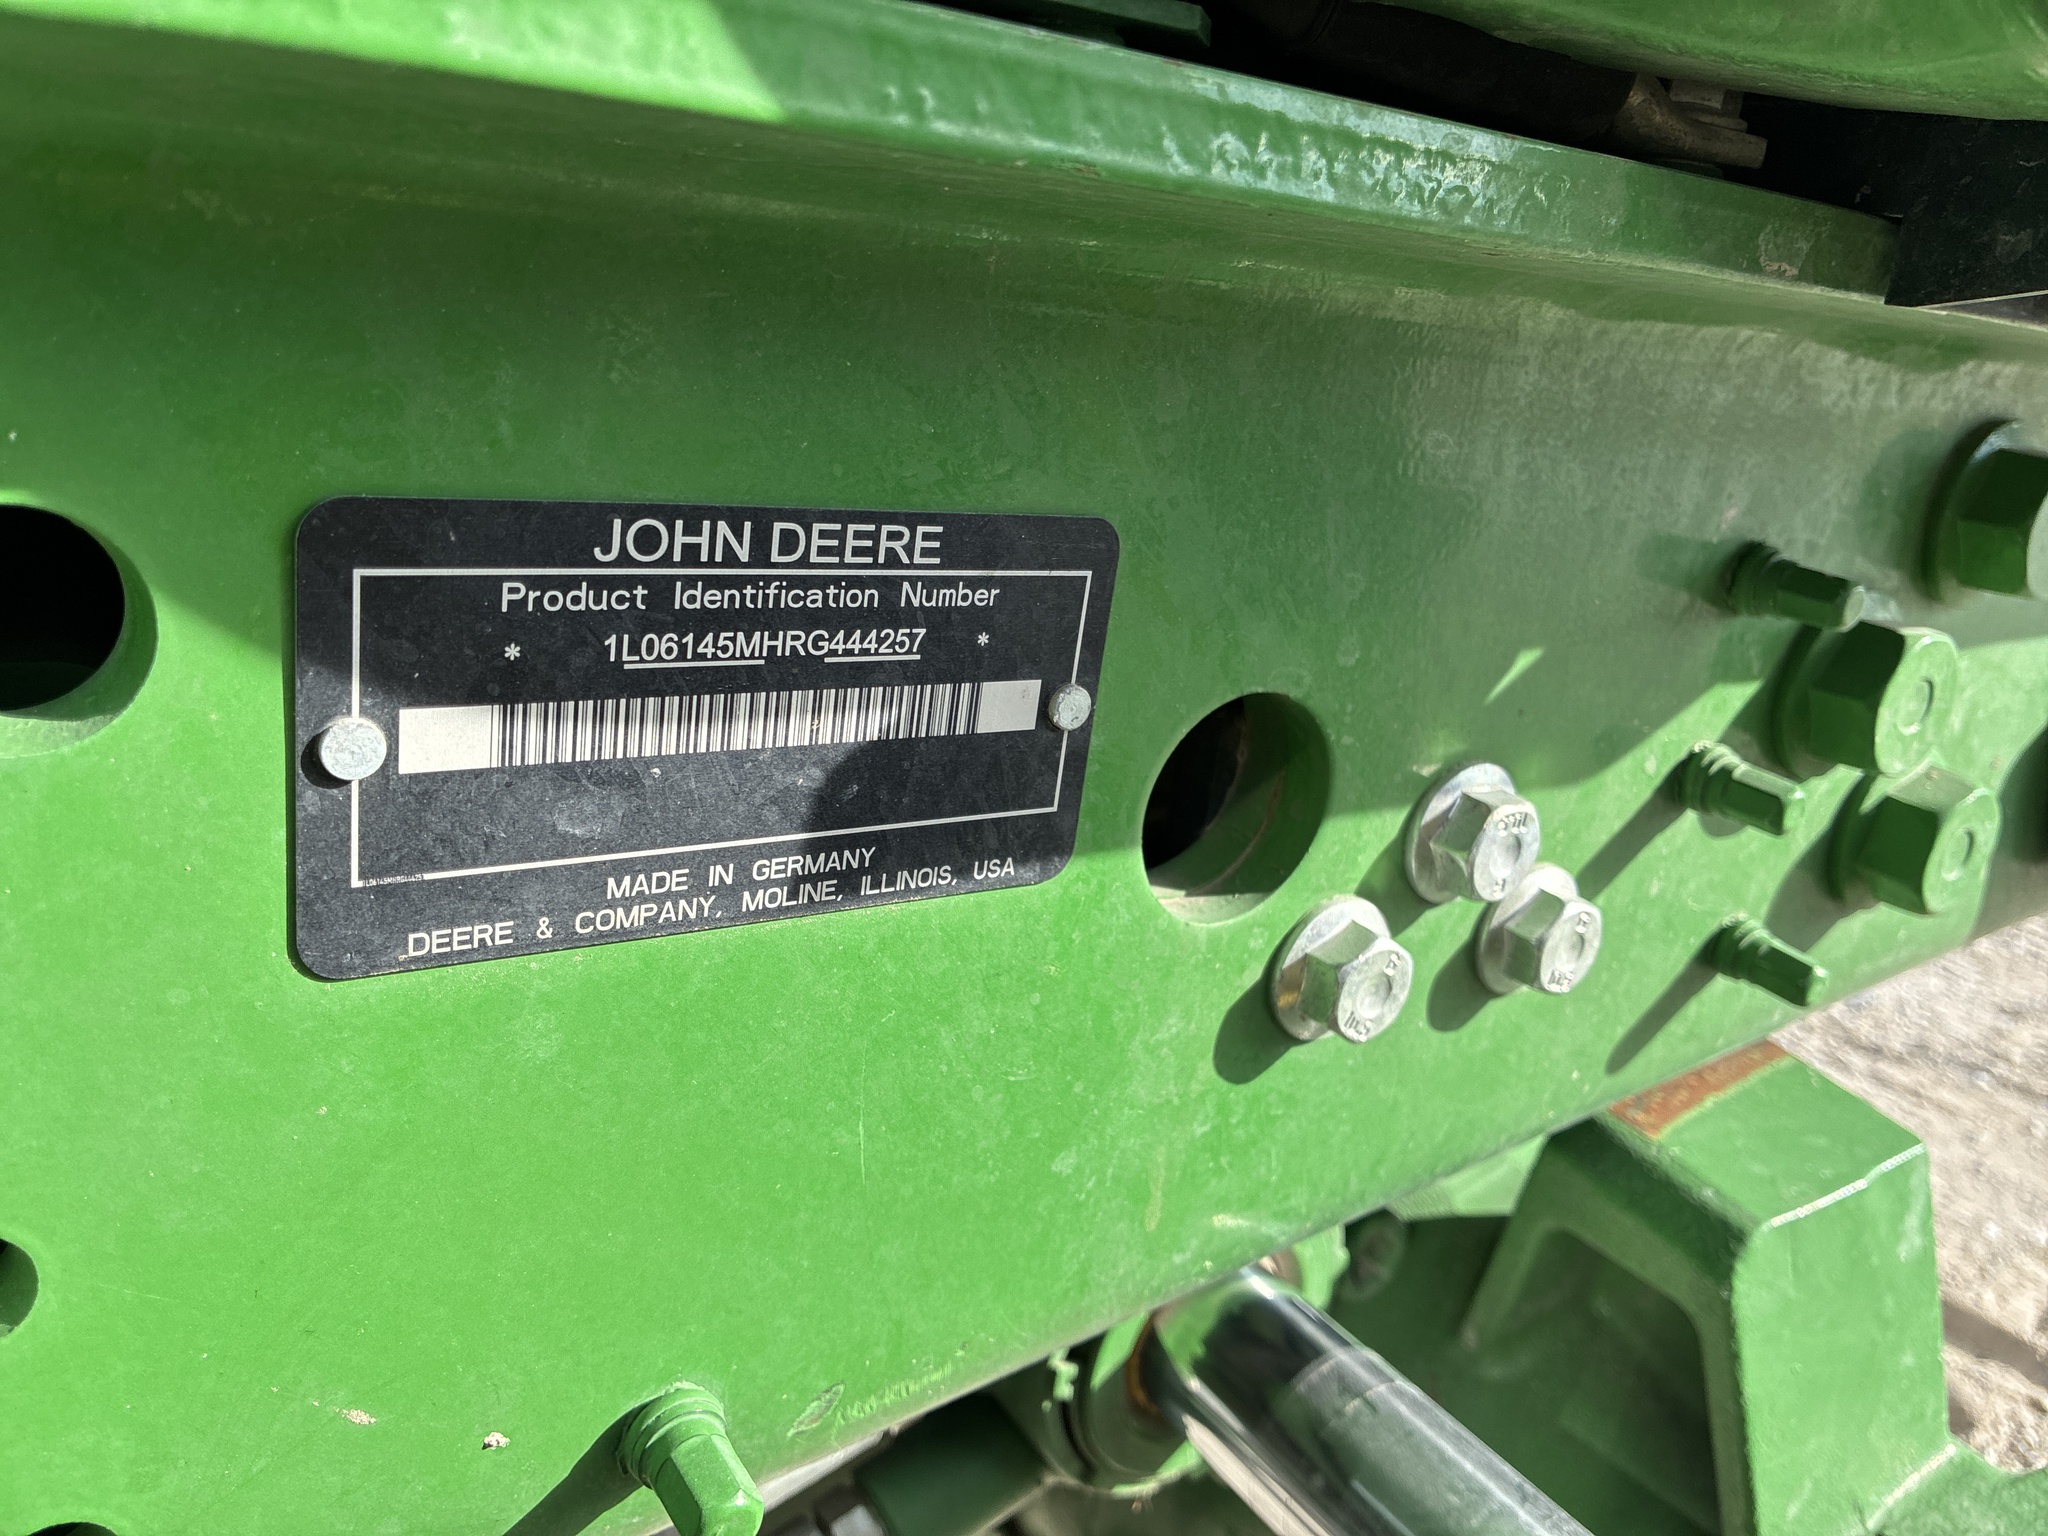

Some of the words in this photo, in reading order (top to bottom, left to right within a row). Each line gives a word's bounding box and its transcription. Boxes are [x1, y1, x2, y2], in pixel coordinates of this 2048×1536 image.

[593, 518, 751, 563] JOHN
[770, 521, 945, 565] DEERE
[501, 580, 649, 612] Product
[674, 581, 880, 611] Identification
[900, 580, 1001, 608] Number
[604, 628, 926, 662] 1L06145MHRG444257
[606, 868, 690, 899] MADE
[708, 863, 734, 887] IN
[752, 846, 877, 881] GERMANY
[408, 920, 514, 957] DEERE
[536, 917, 553, 939] &
[575, 895, 722, 934] COMPANY,
[741, 879, 843, 912] MOLINE,
[860, 865, 958, 896] ILLINOIS,
[973, 857, 1015, 880] USA
